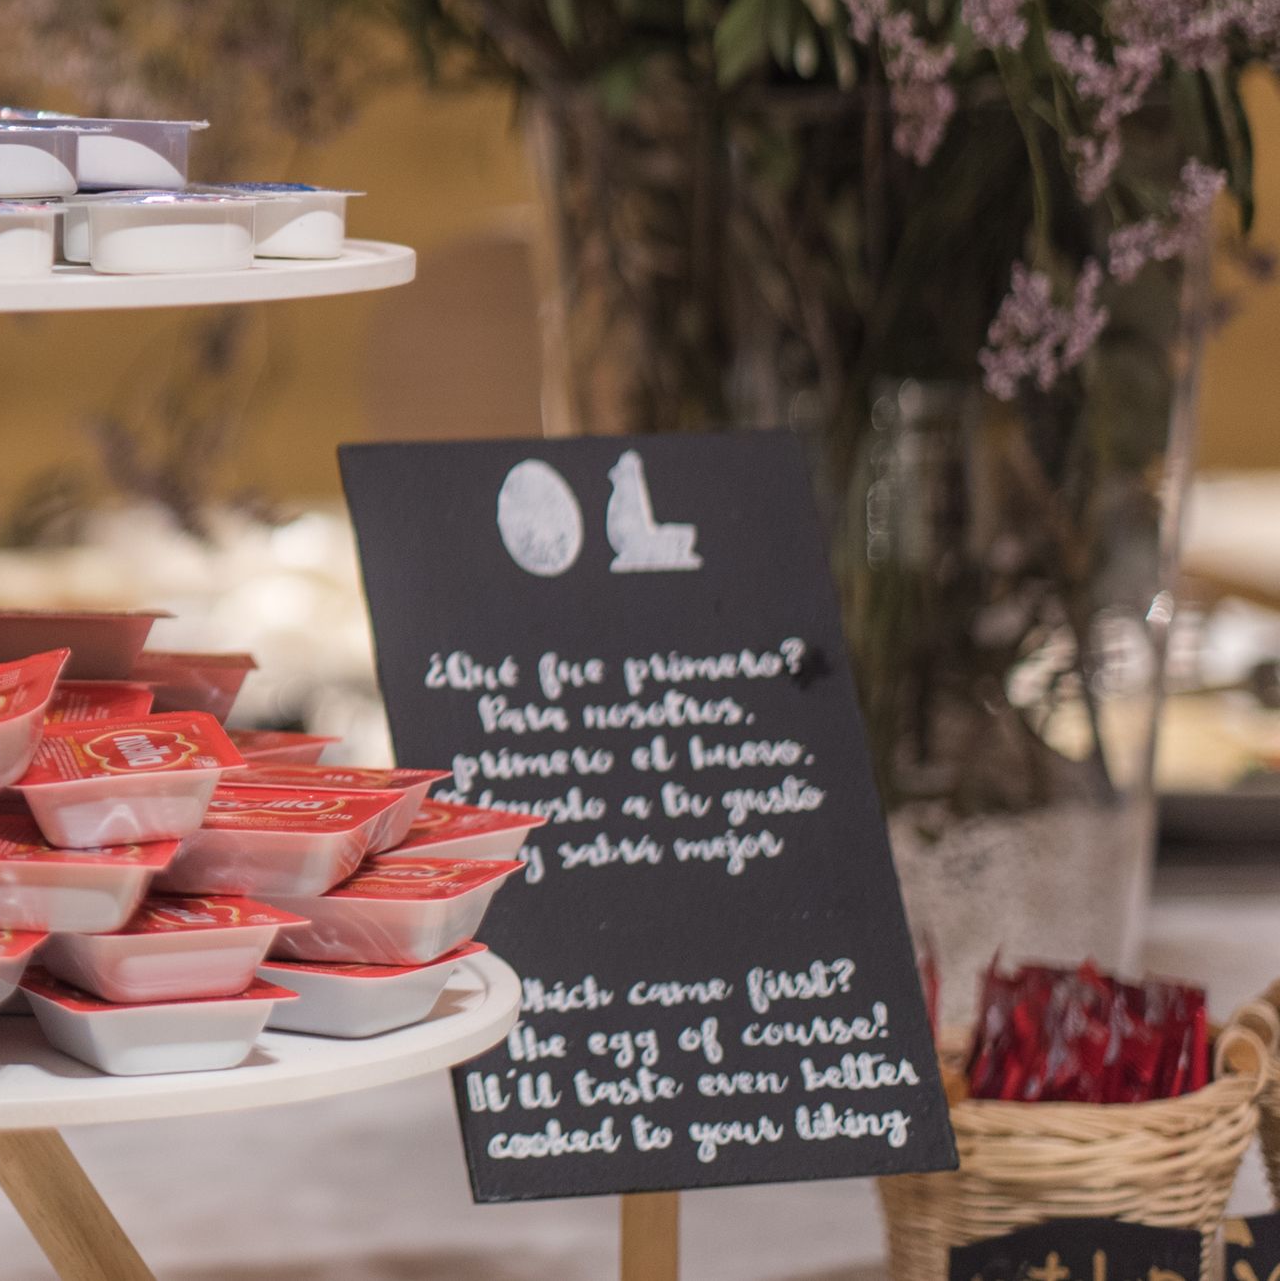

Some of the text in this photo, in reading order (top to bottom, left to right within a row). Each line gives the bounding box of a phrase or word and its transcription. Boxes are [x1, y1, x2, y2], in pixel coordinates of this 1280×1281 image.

[424, 637, 806, 701] ¿Qué fue primero?
[478, 693, 570, 734] Para
[452, 747, 614, 793] primero
[631, 735, 677, 772] el
[209, 797, 325, 811] ocilla
[622, 795, 652, 819] a
[661, 781, 712, 817] tu
[721, 775, 827, 826] gusto
[518, 829, 784, 884] y sabrá mejor
[627, 977, 733, 1007] came
[746, 957, 856, 1014] first?
[506, 1001, 889, 1068] The egg of course!
[573, 1067, 684, 1107] taste
[696, 1070, 789, 1096] even
[799, 1052, 920, 1092] better
[487, 1101, 911, 1163] cooked to your liking
